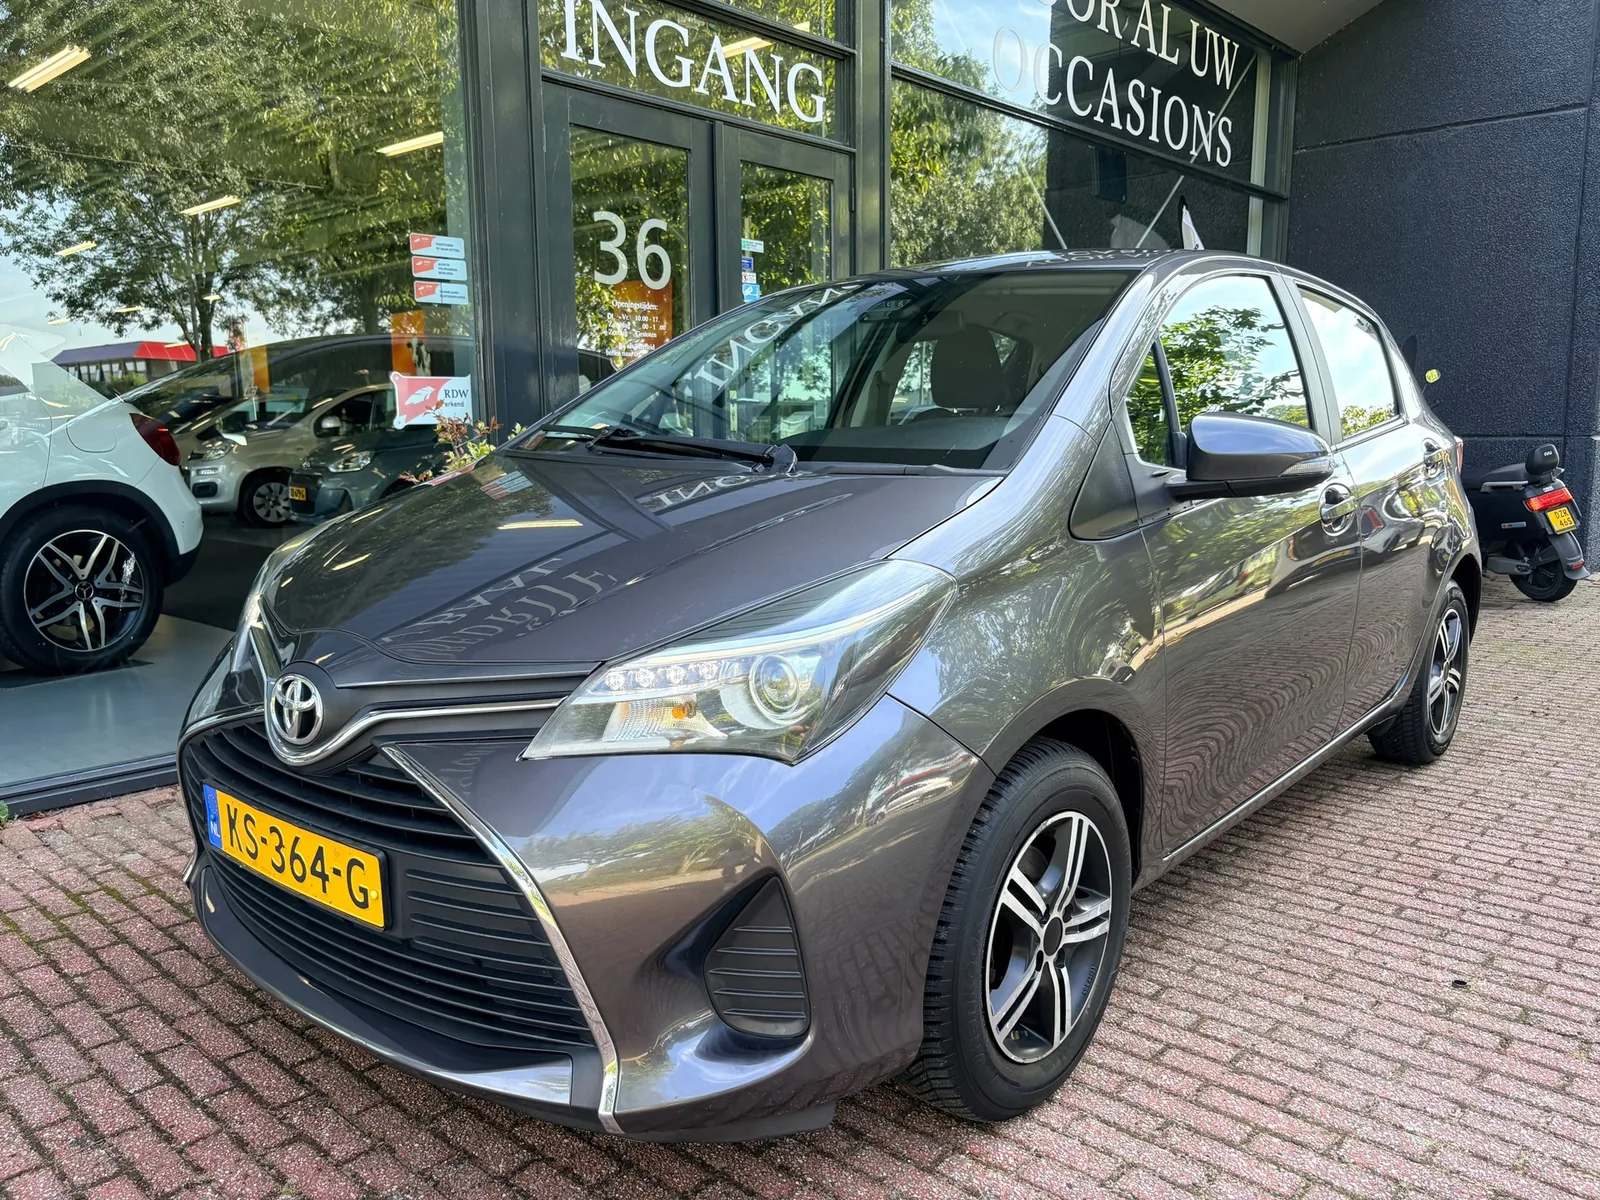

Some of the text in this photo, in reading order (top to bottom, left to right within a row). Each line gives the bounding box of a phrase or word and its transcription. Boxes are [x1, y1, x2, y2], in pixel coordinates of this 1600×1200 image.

[560, 0, 827, 123] INGANG
[1130, 0, 1180, 65] AL
[1189, 18, 1240, 90] UW
[992, 26, 1233, 168] OCCASIONS
[593, 210, 672, 290] 36
[444, 389, 469, 399] RDW
[1554, 508, 1569, 519] DZR
[210, 803, 370, 910] NL KS-364-G
